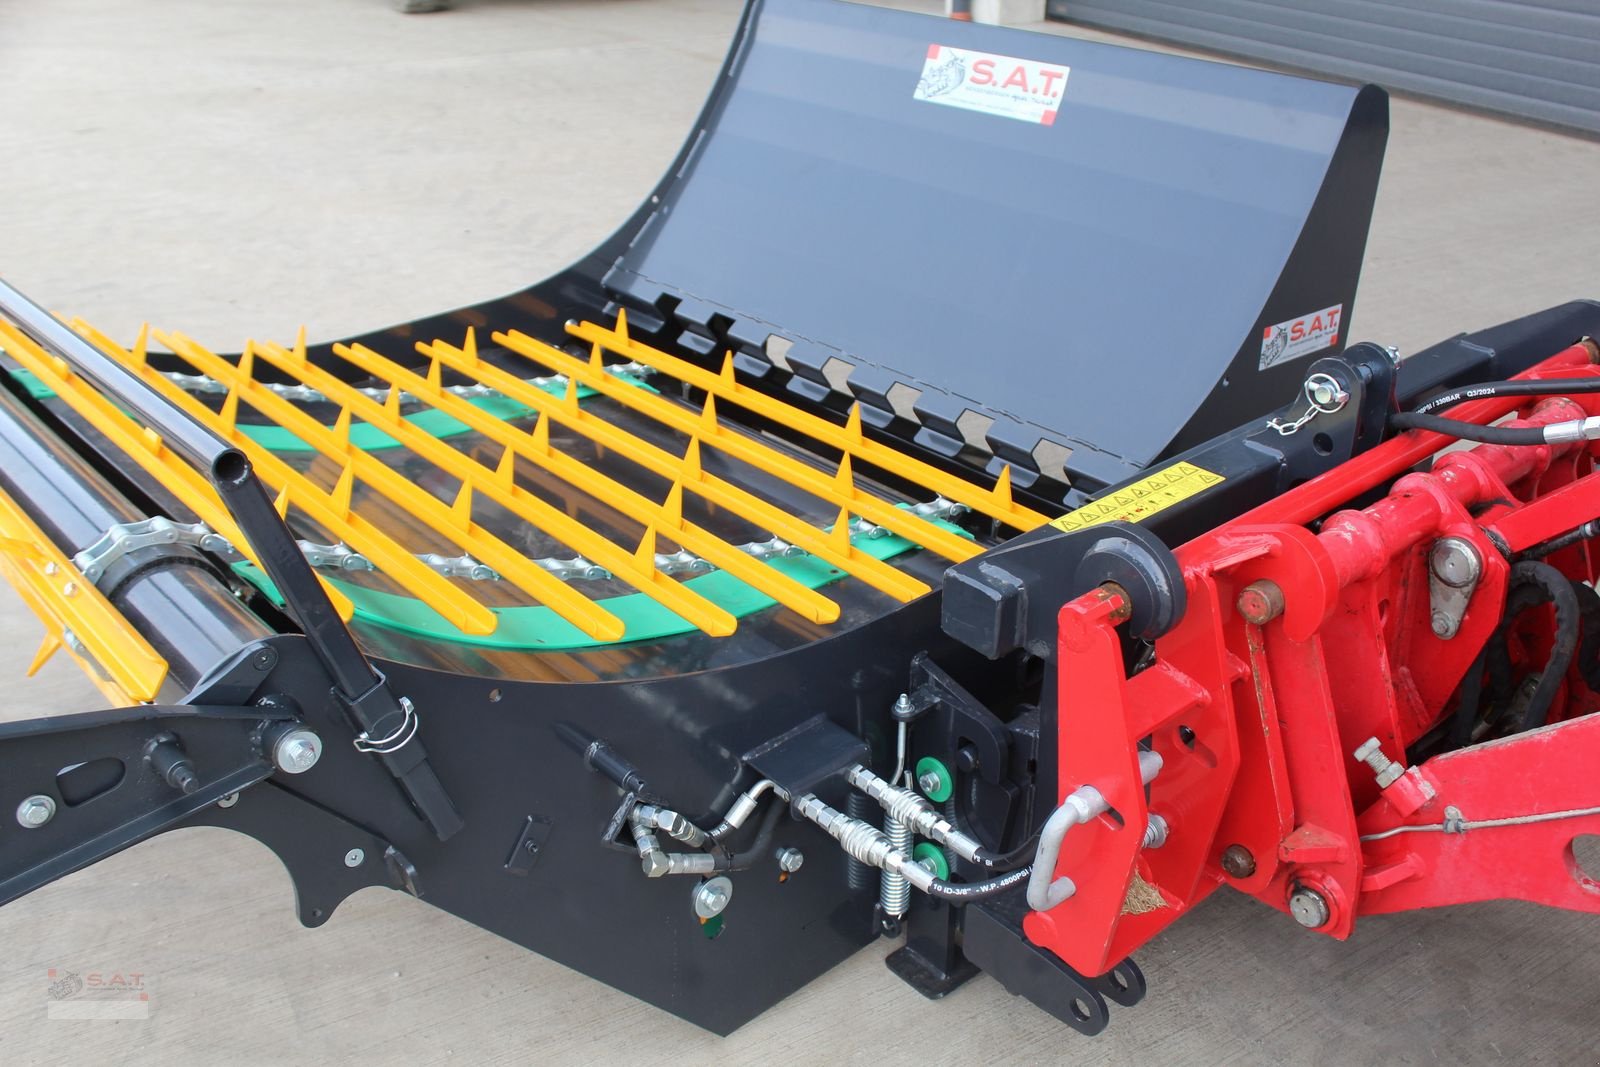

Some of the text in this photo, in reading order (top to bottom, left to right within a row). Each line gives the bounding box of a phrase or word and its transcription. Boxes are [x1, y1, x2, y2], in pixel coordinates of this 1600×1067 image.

[969, 58, 1064, 98] S.A.T.
[1289, 308, 1340, 341] S.A.T.
[1466, 387, 1495, 397] Q3/2024
[980, 882, 1000, 893] W.P.
[1000, 868, 1030, 887] 4800PSI
